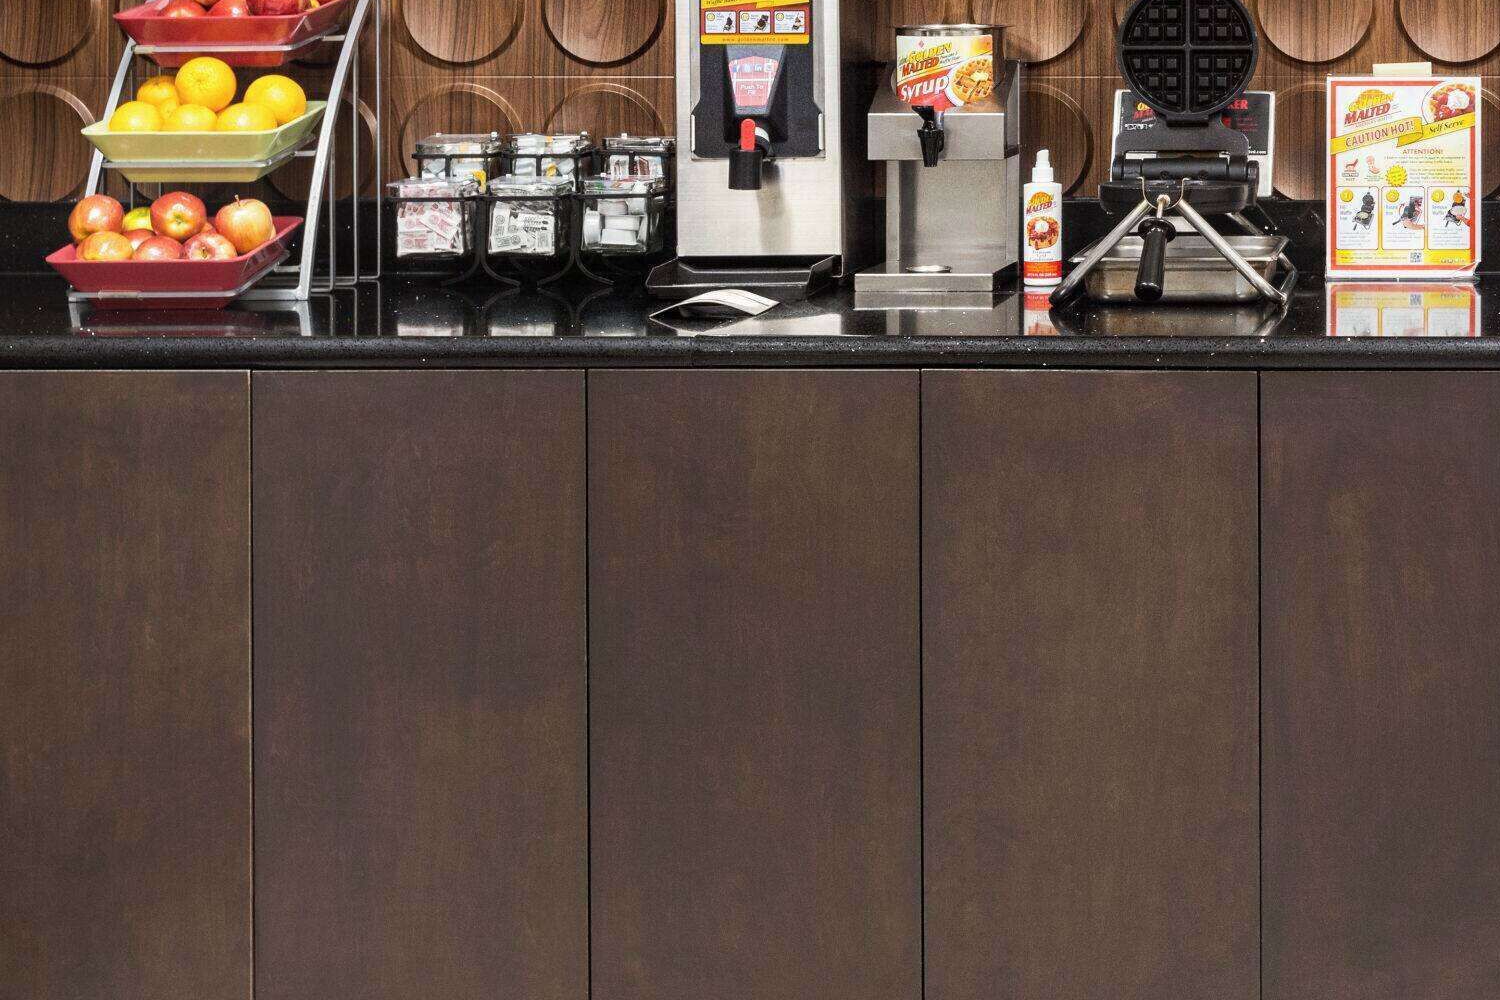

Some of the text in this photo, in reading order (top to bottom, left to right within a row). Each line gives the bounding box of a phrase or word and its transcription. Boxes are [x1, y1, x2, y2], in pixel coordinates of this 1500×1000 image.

[908, 42, 952, 63] GOLDEN
[902, 57, 939, 76] MALTED
[1344, 103, 1391, 125] MALTED
[1345, 120, 1414, 147] CAUTION HOT!
[1429, 119, 1464, 134] Self Serve
[1026, 201, 1052, 214] MALTED
